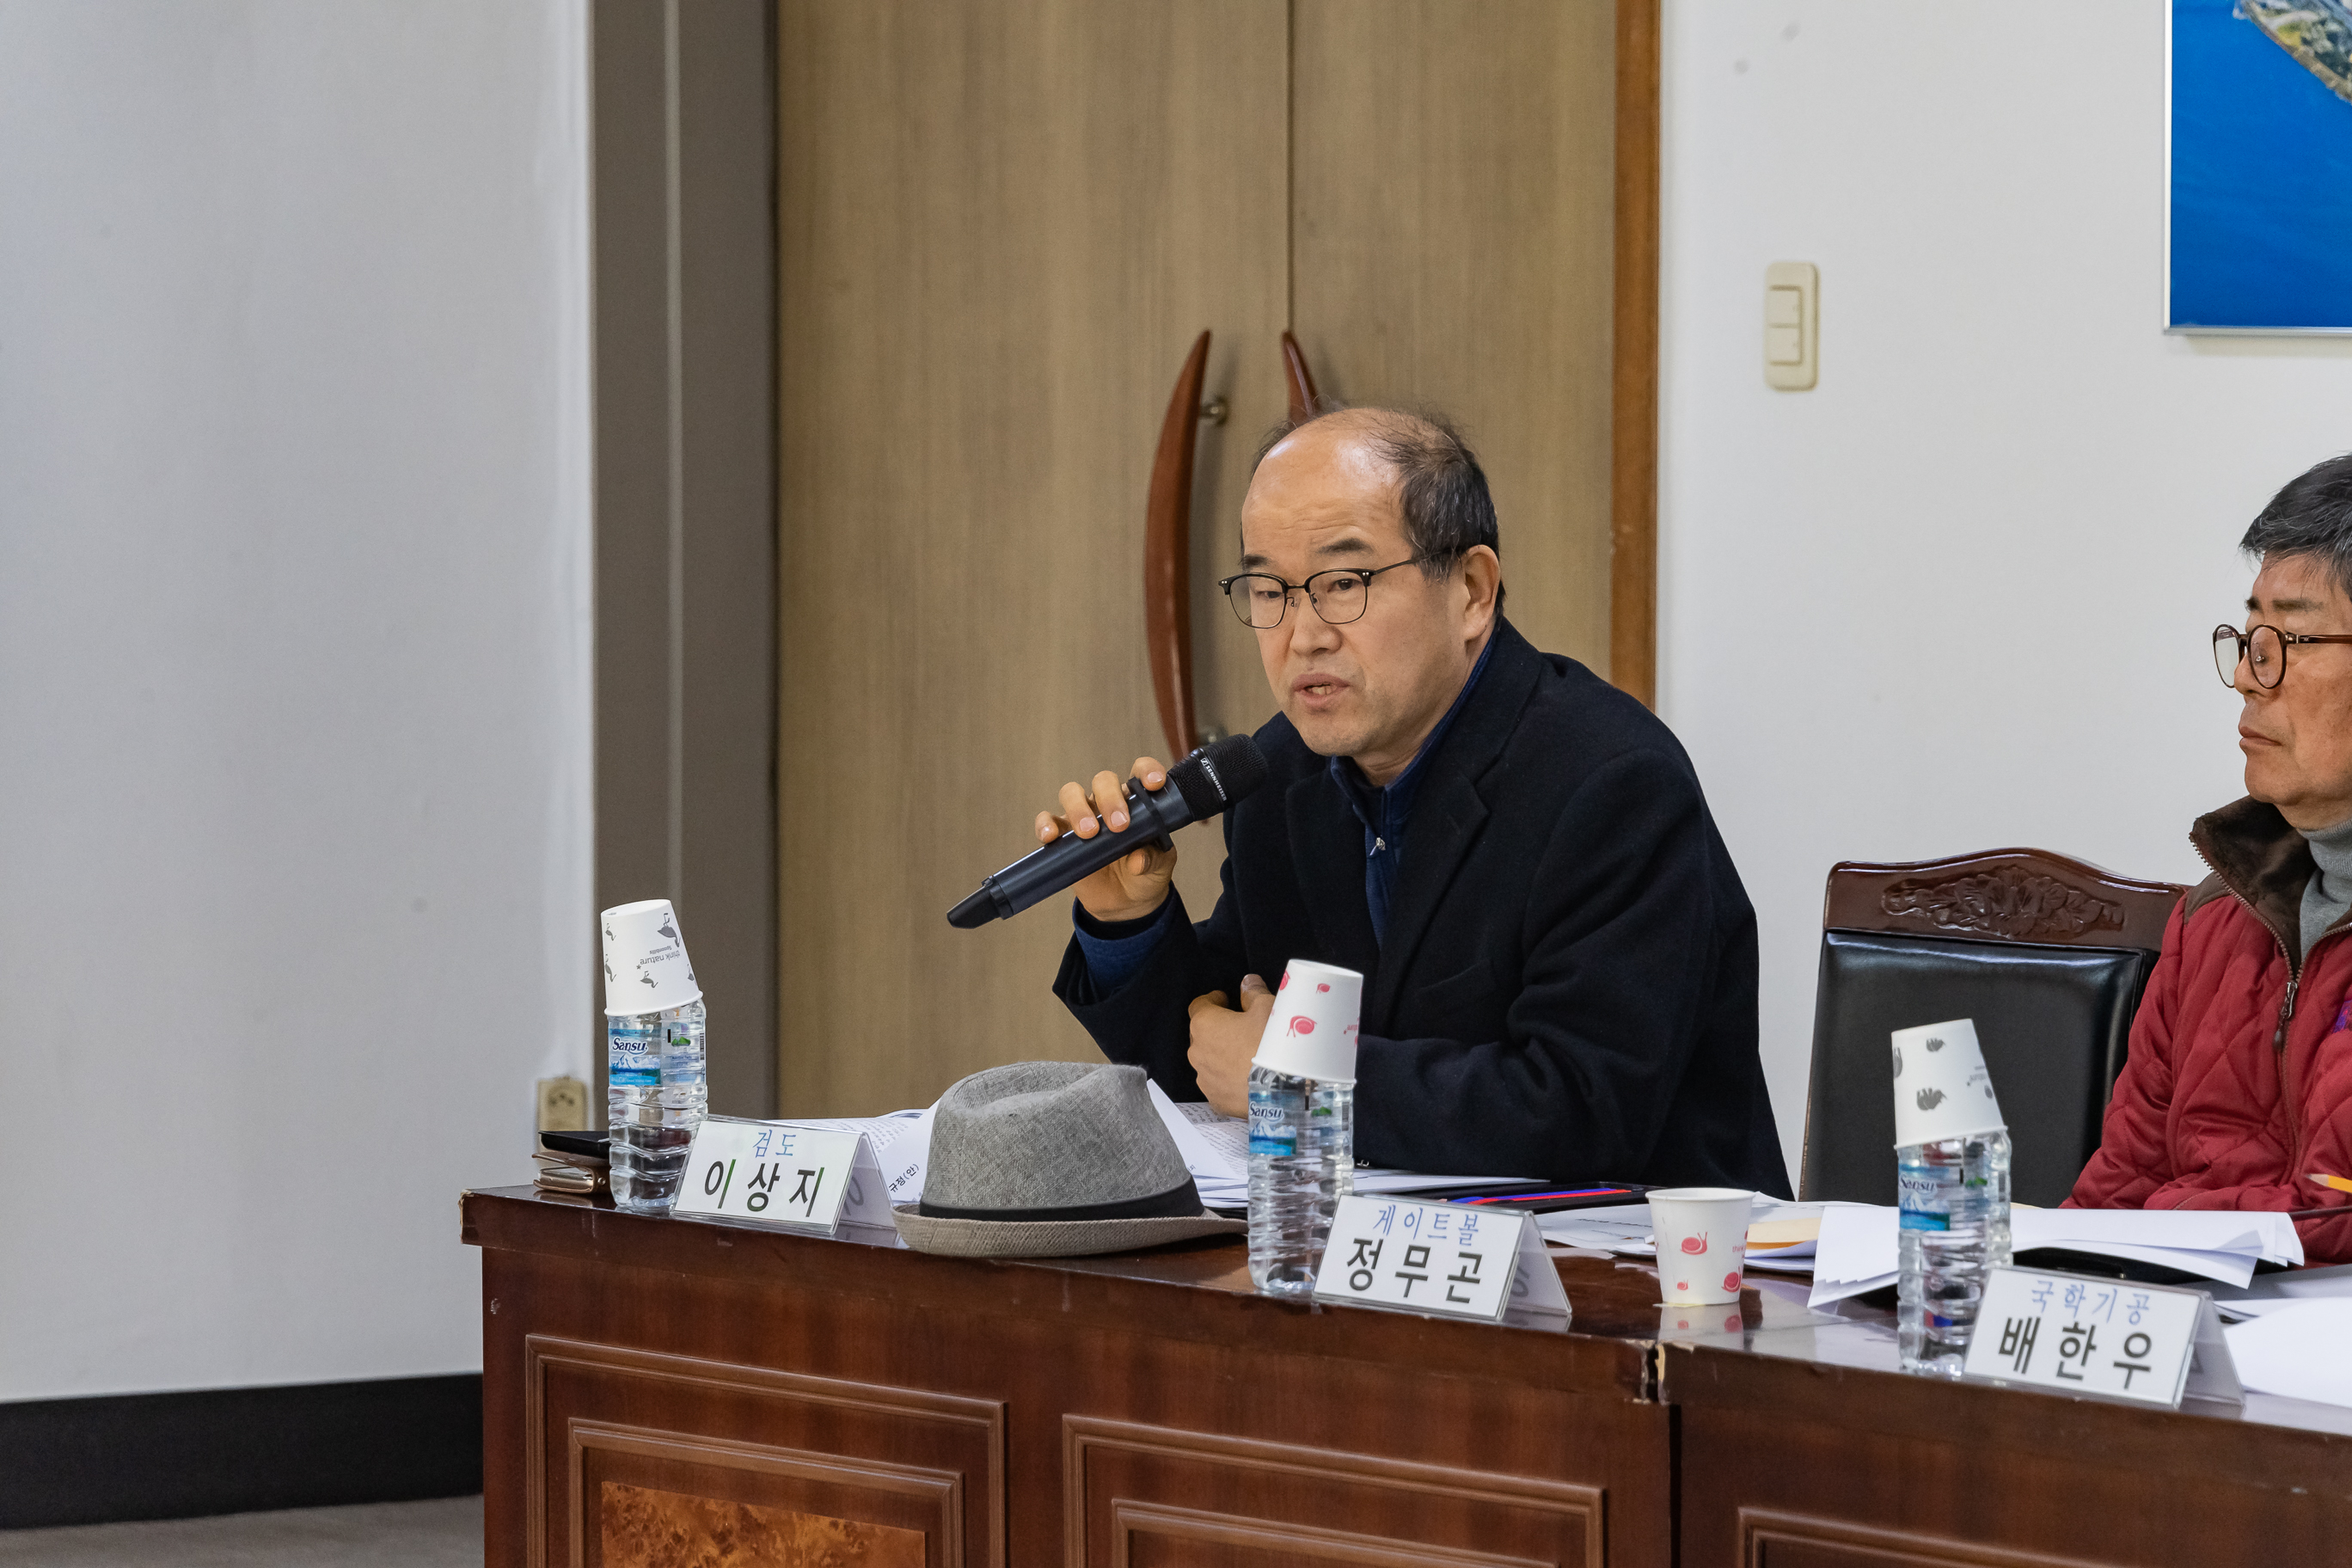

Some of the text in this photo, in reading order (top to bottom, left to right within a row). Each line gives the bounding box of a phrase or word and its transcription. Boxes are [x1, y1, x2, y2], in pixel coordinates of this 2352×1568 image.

[1205, 764, 1228, 801] SENNHEISER
[640, 950, 681, 965] think nature
[612, 1037, 646, 1051] Sansu
[1249, 1101, 1283, 1118] Sansu
[751, 1129, 797, 1159] 검도
[703, 1158, 825, 1218] 이상지
[888, 1163, 920, 1193] 규정(안)
[1373, 1204, 1480, 1246] 게이트볼
[1346, 1237, 1484, 1304] 정무곤
[2031, 1280, 2151, 1326] 국학기공
[1999, 1316, 2153, 1391] 배한우
